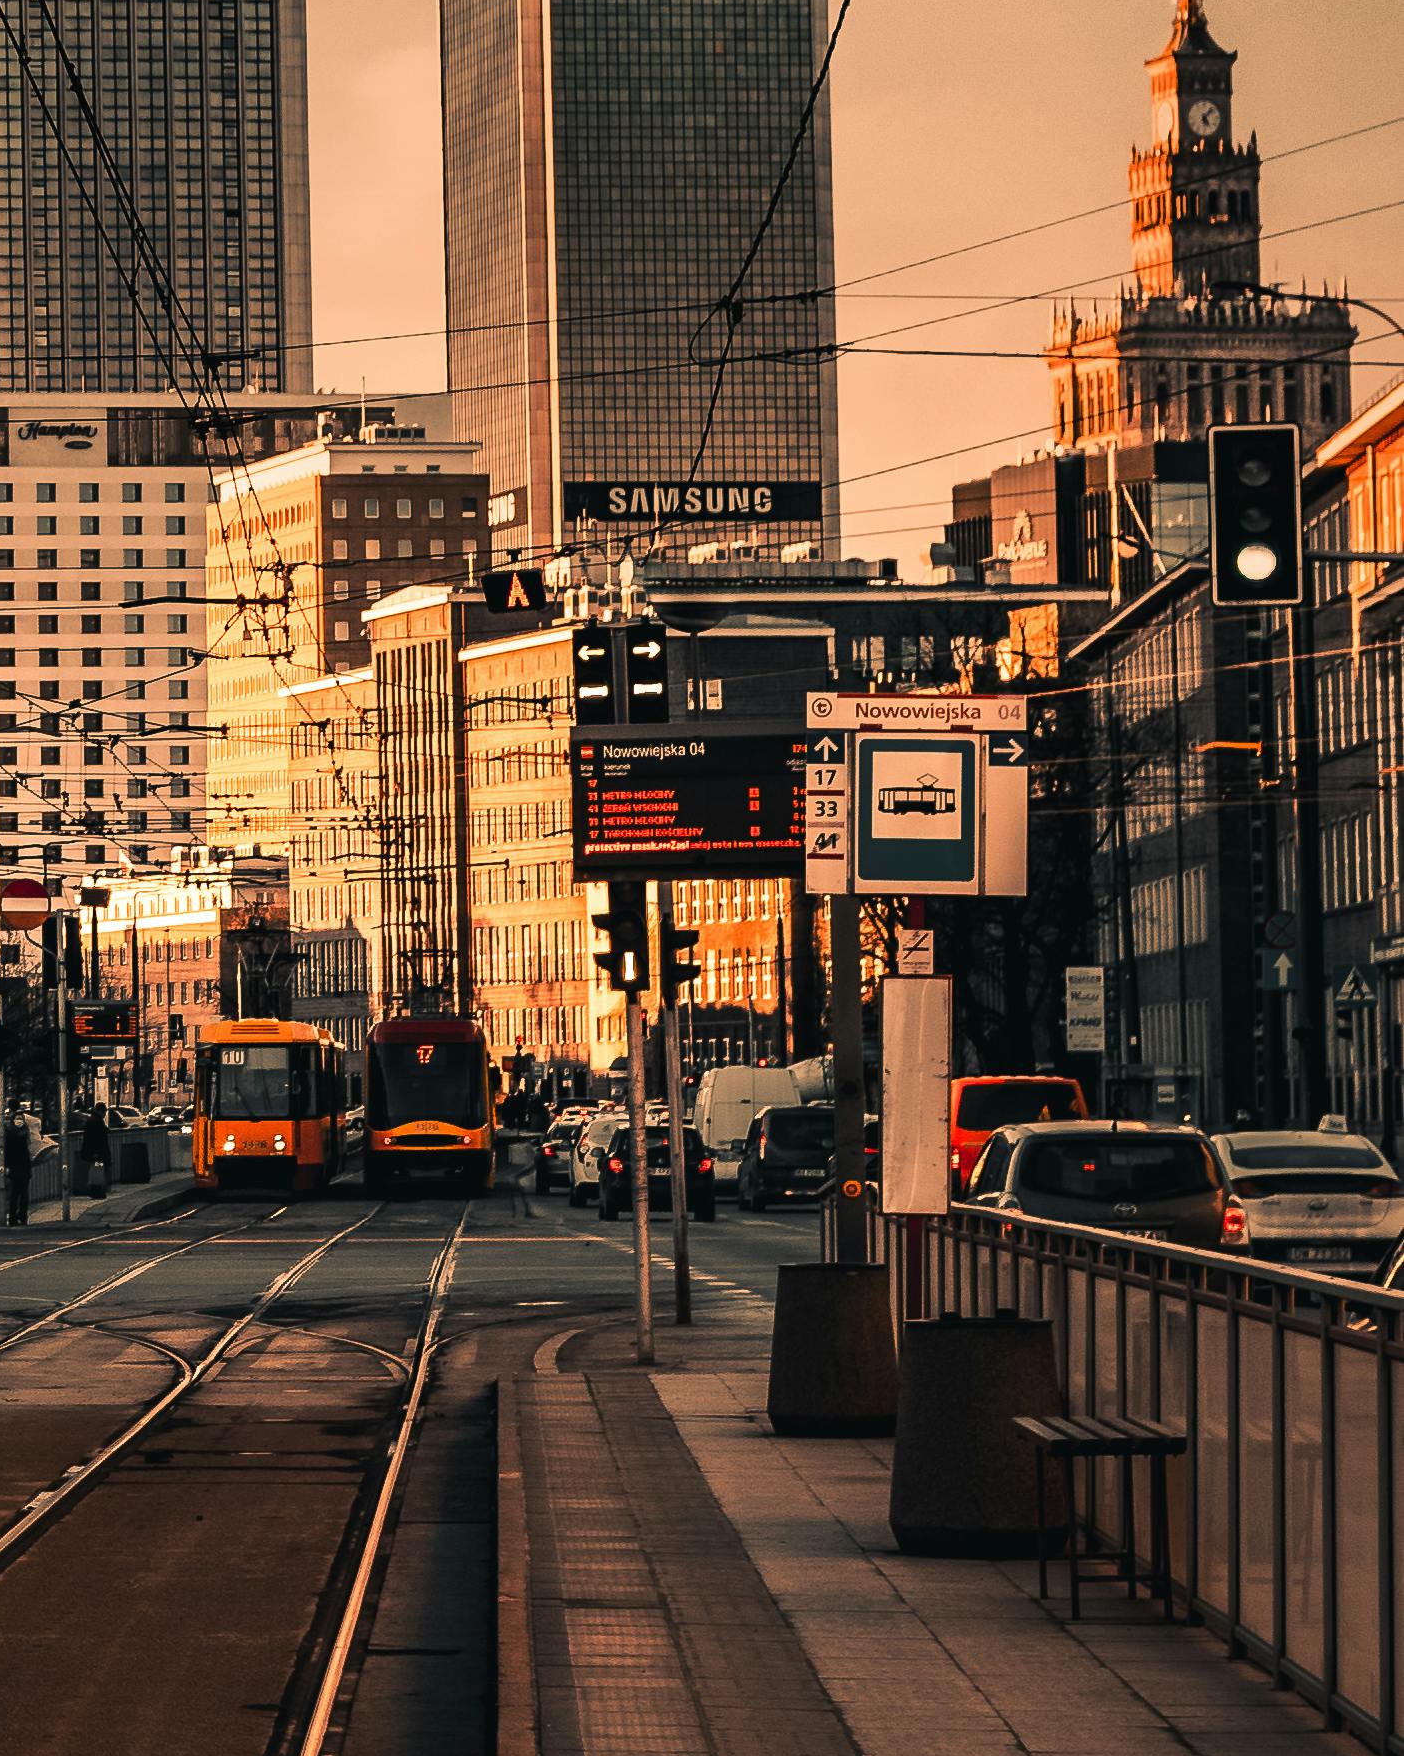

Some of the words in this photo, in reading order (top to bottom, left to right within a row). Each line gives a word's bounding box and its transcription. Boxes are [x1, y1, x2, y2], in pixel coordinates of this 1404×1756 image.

[17, 422, 98, 440] Hampton
[608, 486, 773, 514] SAMSUNG
[854, 701, 982, 724] Nowowiejska
[997, 703, 1022, 721] 04
[603, 743, 686, 761] Nowowiejska
[688, 741, 705, 756] 04
[814, 769, 837, 786] 17
[814, 800, 838, 818] 33
[416, 1044, 435, 1064] 17
